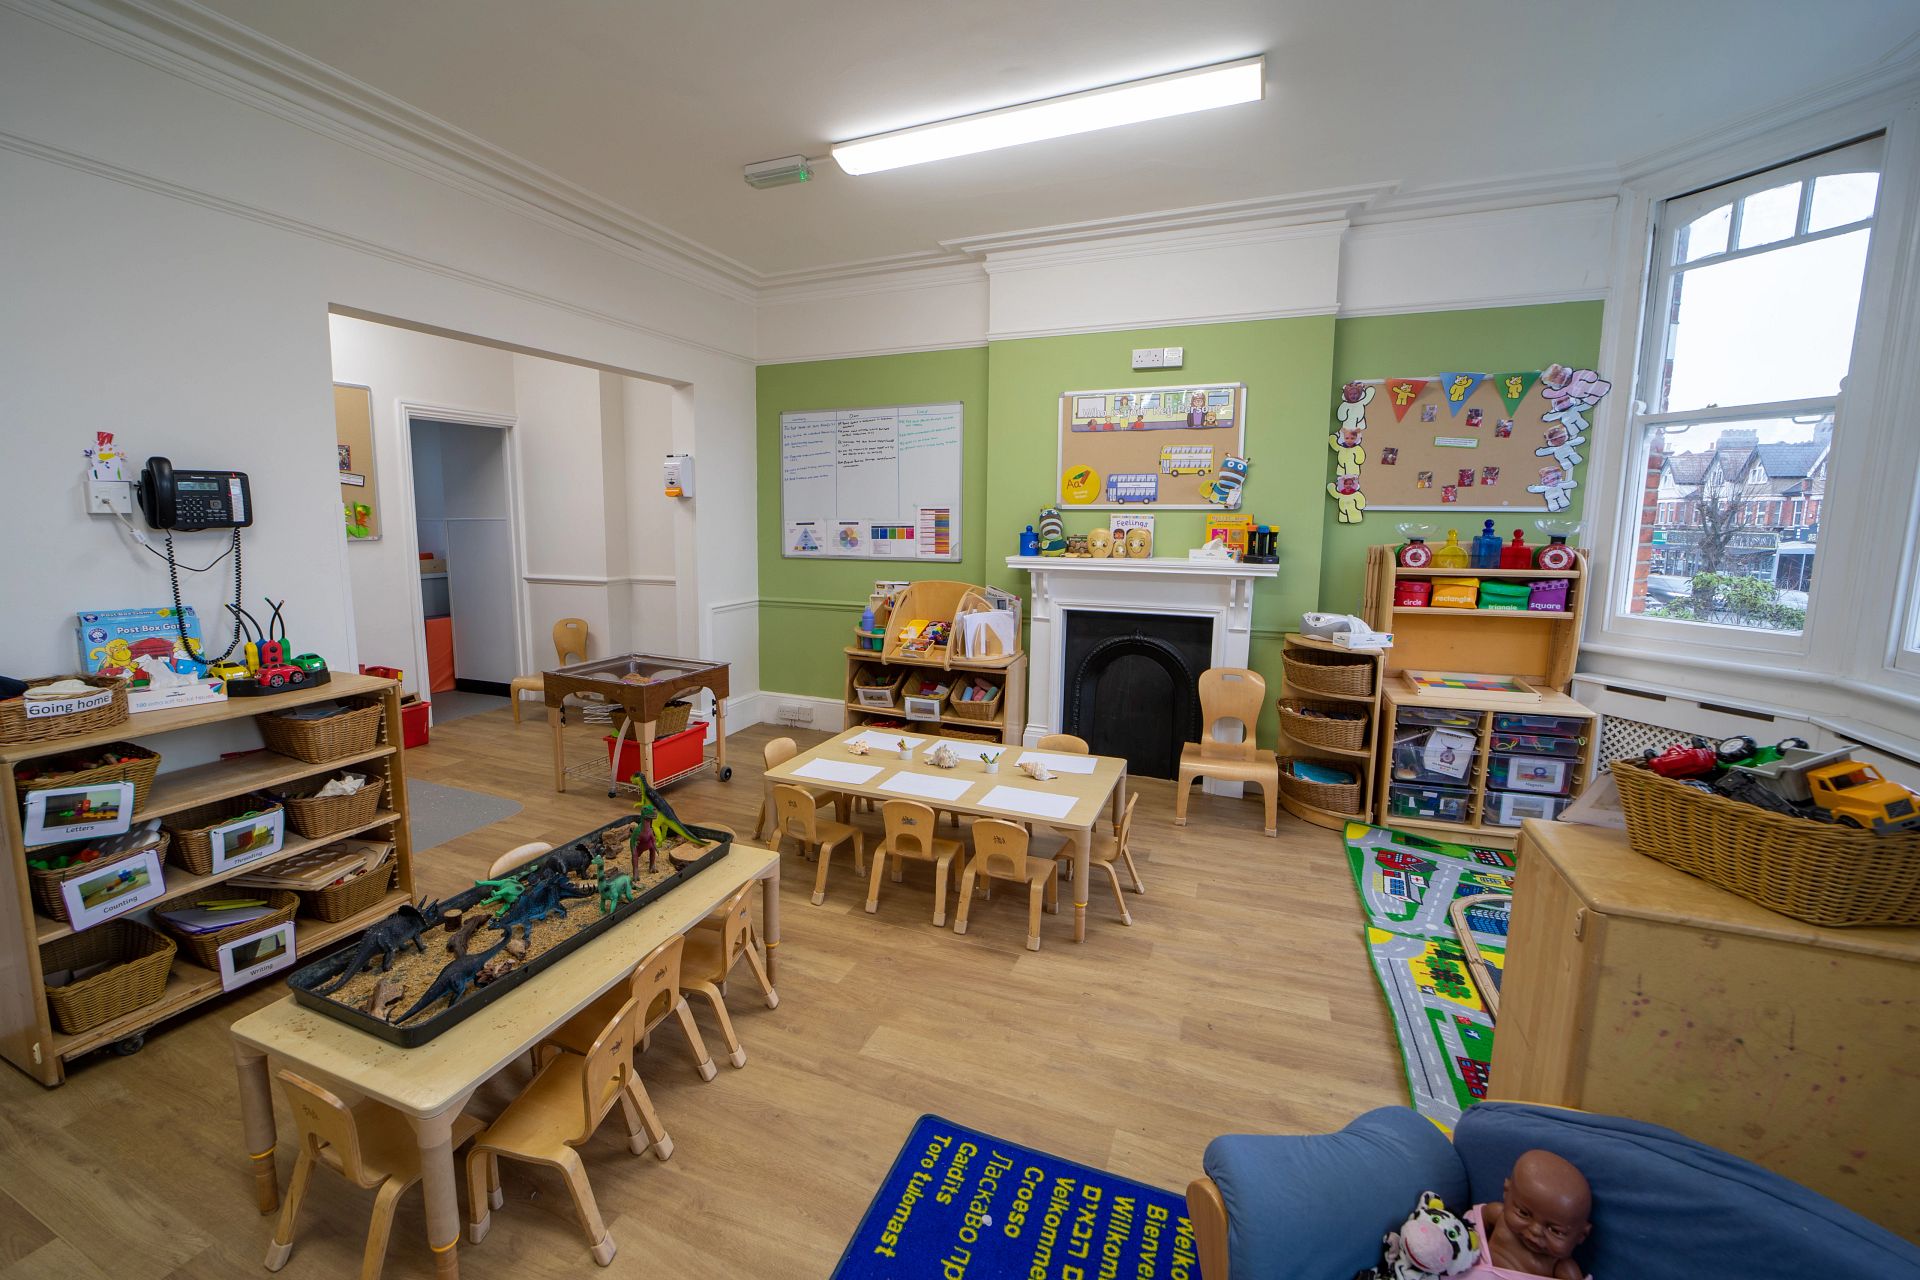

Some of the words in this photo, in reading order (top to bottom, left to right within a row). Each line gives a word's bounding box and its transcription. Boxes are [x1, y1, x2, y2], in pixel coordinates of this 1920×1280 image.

[1435, 595, 1472, 604] rectangle
[1530, 602, 1561, 610] square
[117, 626, 140, 634] Post
[142, 624, 161, 632] Box
[29, 701, 73, 715] Going
[77, 694, 110, 709] home
[65, 824, 95, 834] Letters
[234, 850, 263, 865] Threading
[103, 894, 138, 914] Counting
[249, 962, 274, 977] Writing
[1003, 1166, 1045, 1239] Croeso
[1027, 1177, 1077, 1280] Velkomme
[1097, 1196, 1136, 1280] Willkom
